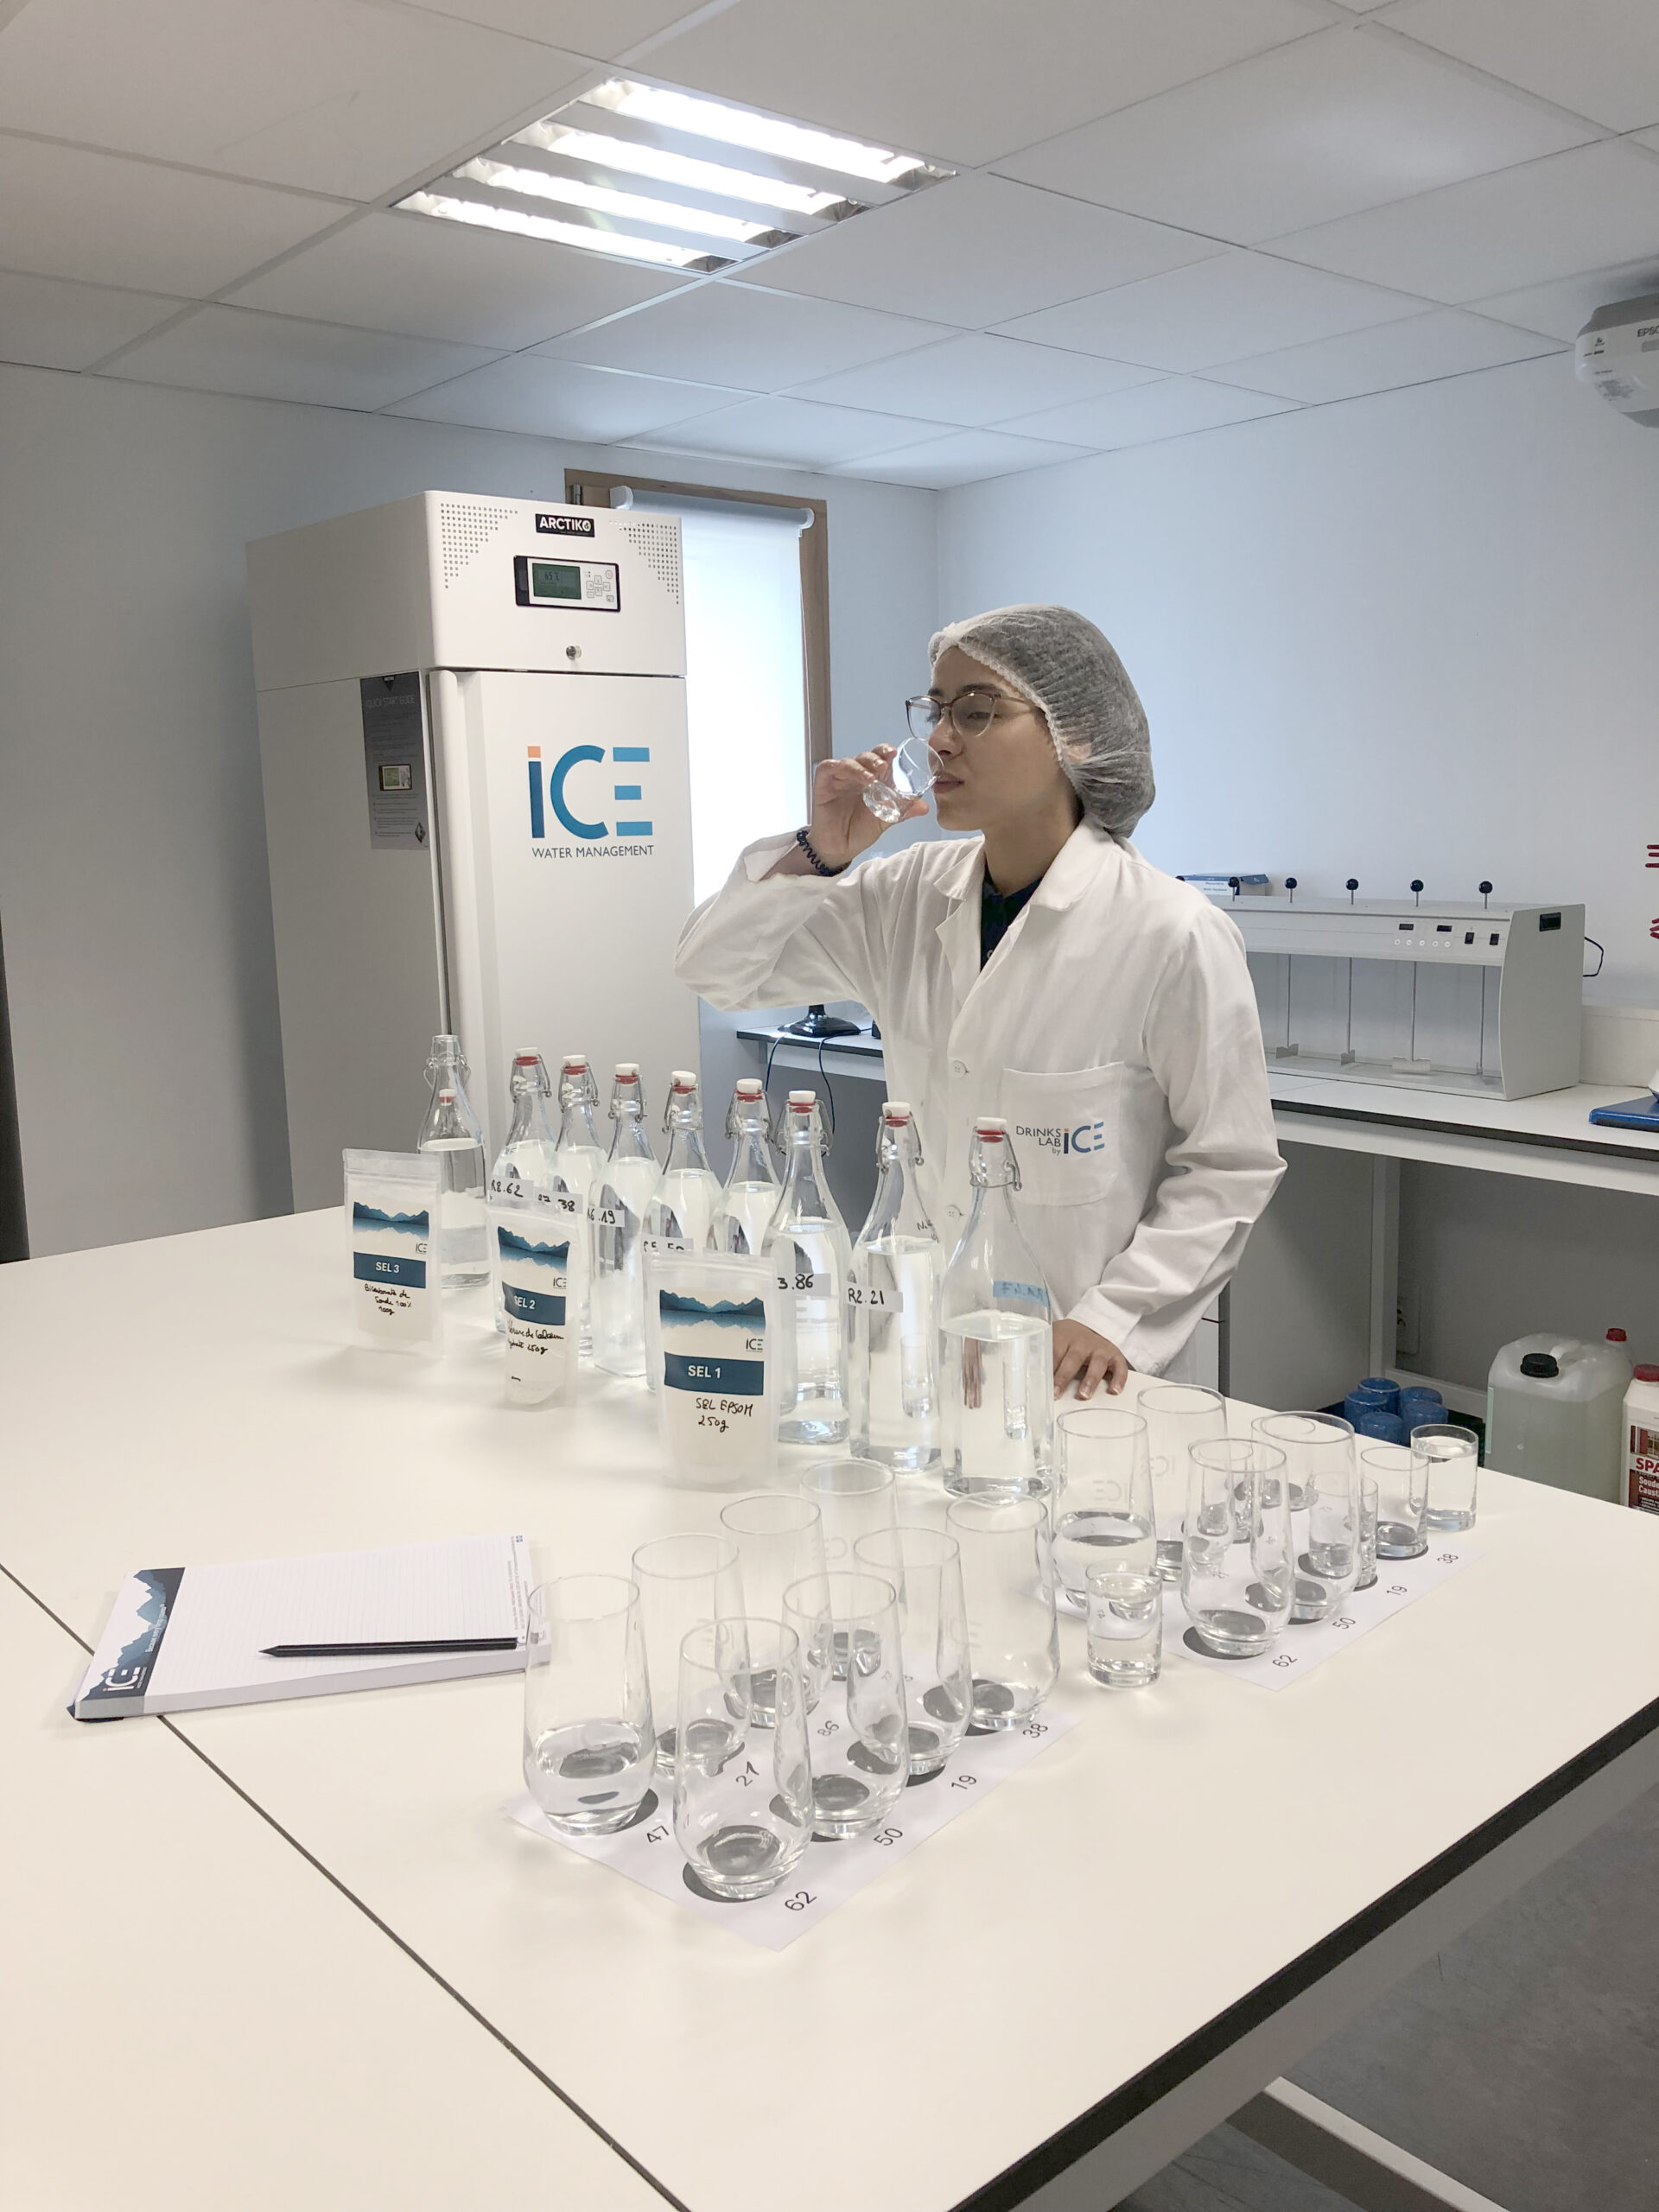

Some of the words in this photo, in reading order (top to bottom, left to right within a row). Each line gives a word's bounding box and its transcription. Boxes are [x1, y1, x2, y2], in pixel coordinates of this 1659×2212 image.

[539, 516, 592, 532] ARCTIKO
[531, 847, 573, 859] WATER
[575, 844, 655, 858] MANAGEMENT
[1016, 1126, 1062, 1138] DRINKS
[1039, 1137, 1062, 1147] LAB
[1052, 1147, 1062, 1156] by
[375, 1262, 392, 1273] SEL
[393, 1264, 400, 1274] 3
[399, 1289, 410, 1299] de
[513, 1295, 528, 1308] SEL
[529, 1300, 536, 1310] 2
[525, 1327, 534, 1339] de
[688, 1364, 712, 1378] SEL
[715, 1367, 721, 1379] 1
[696, 1397, 716, 1410] SEL
[720, 1399, 753, 1417] EPSOM
[698, 1414, 729, 1433] 250g
[1437, 1553, 1459, 1564] 38
[1386, 1585, 1408, 1596] 19
[1332, 1617, 1356, 1630] 50
[1272, 1654, 1298, 1668] 62
[817, 1720, 840, 1738] 86
[1022, 1723, 1049, 1738] 38
[951, 1774, 977, 1791] 19
[647, 1825, 670, 1843] 47
[873, 1827, 904, 1847] 50
[785, 1891, 817, 1912] 62
